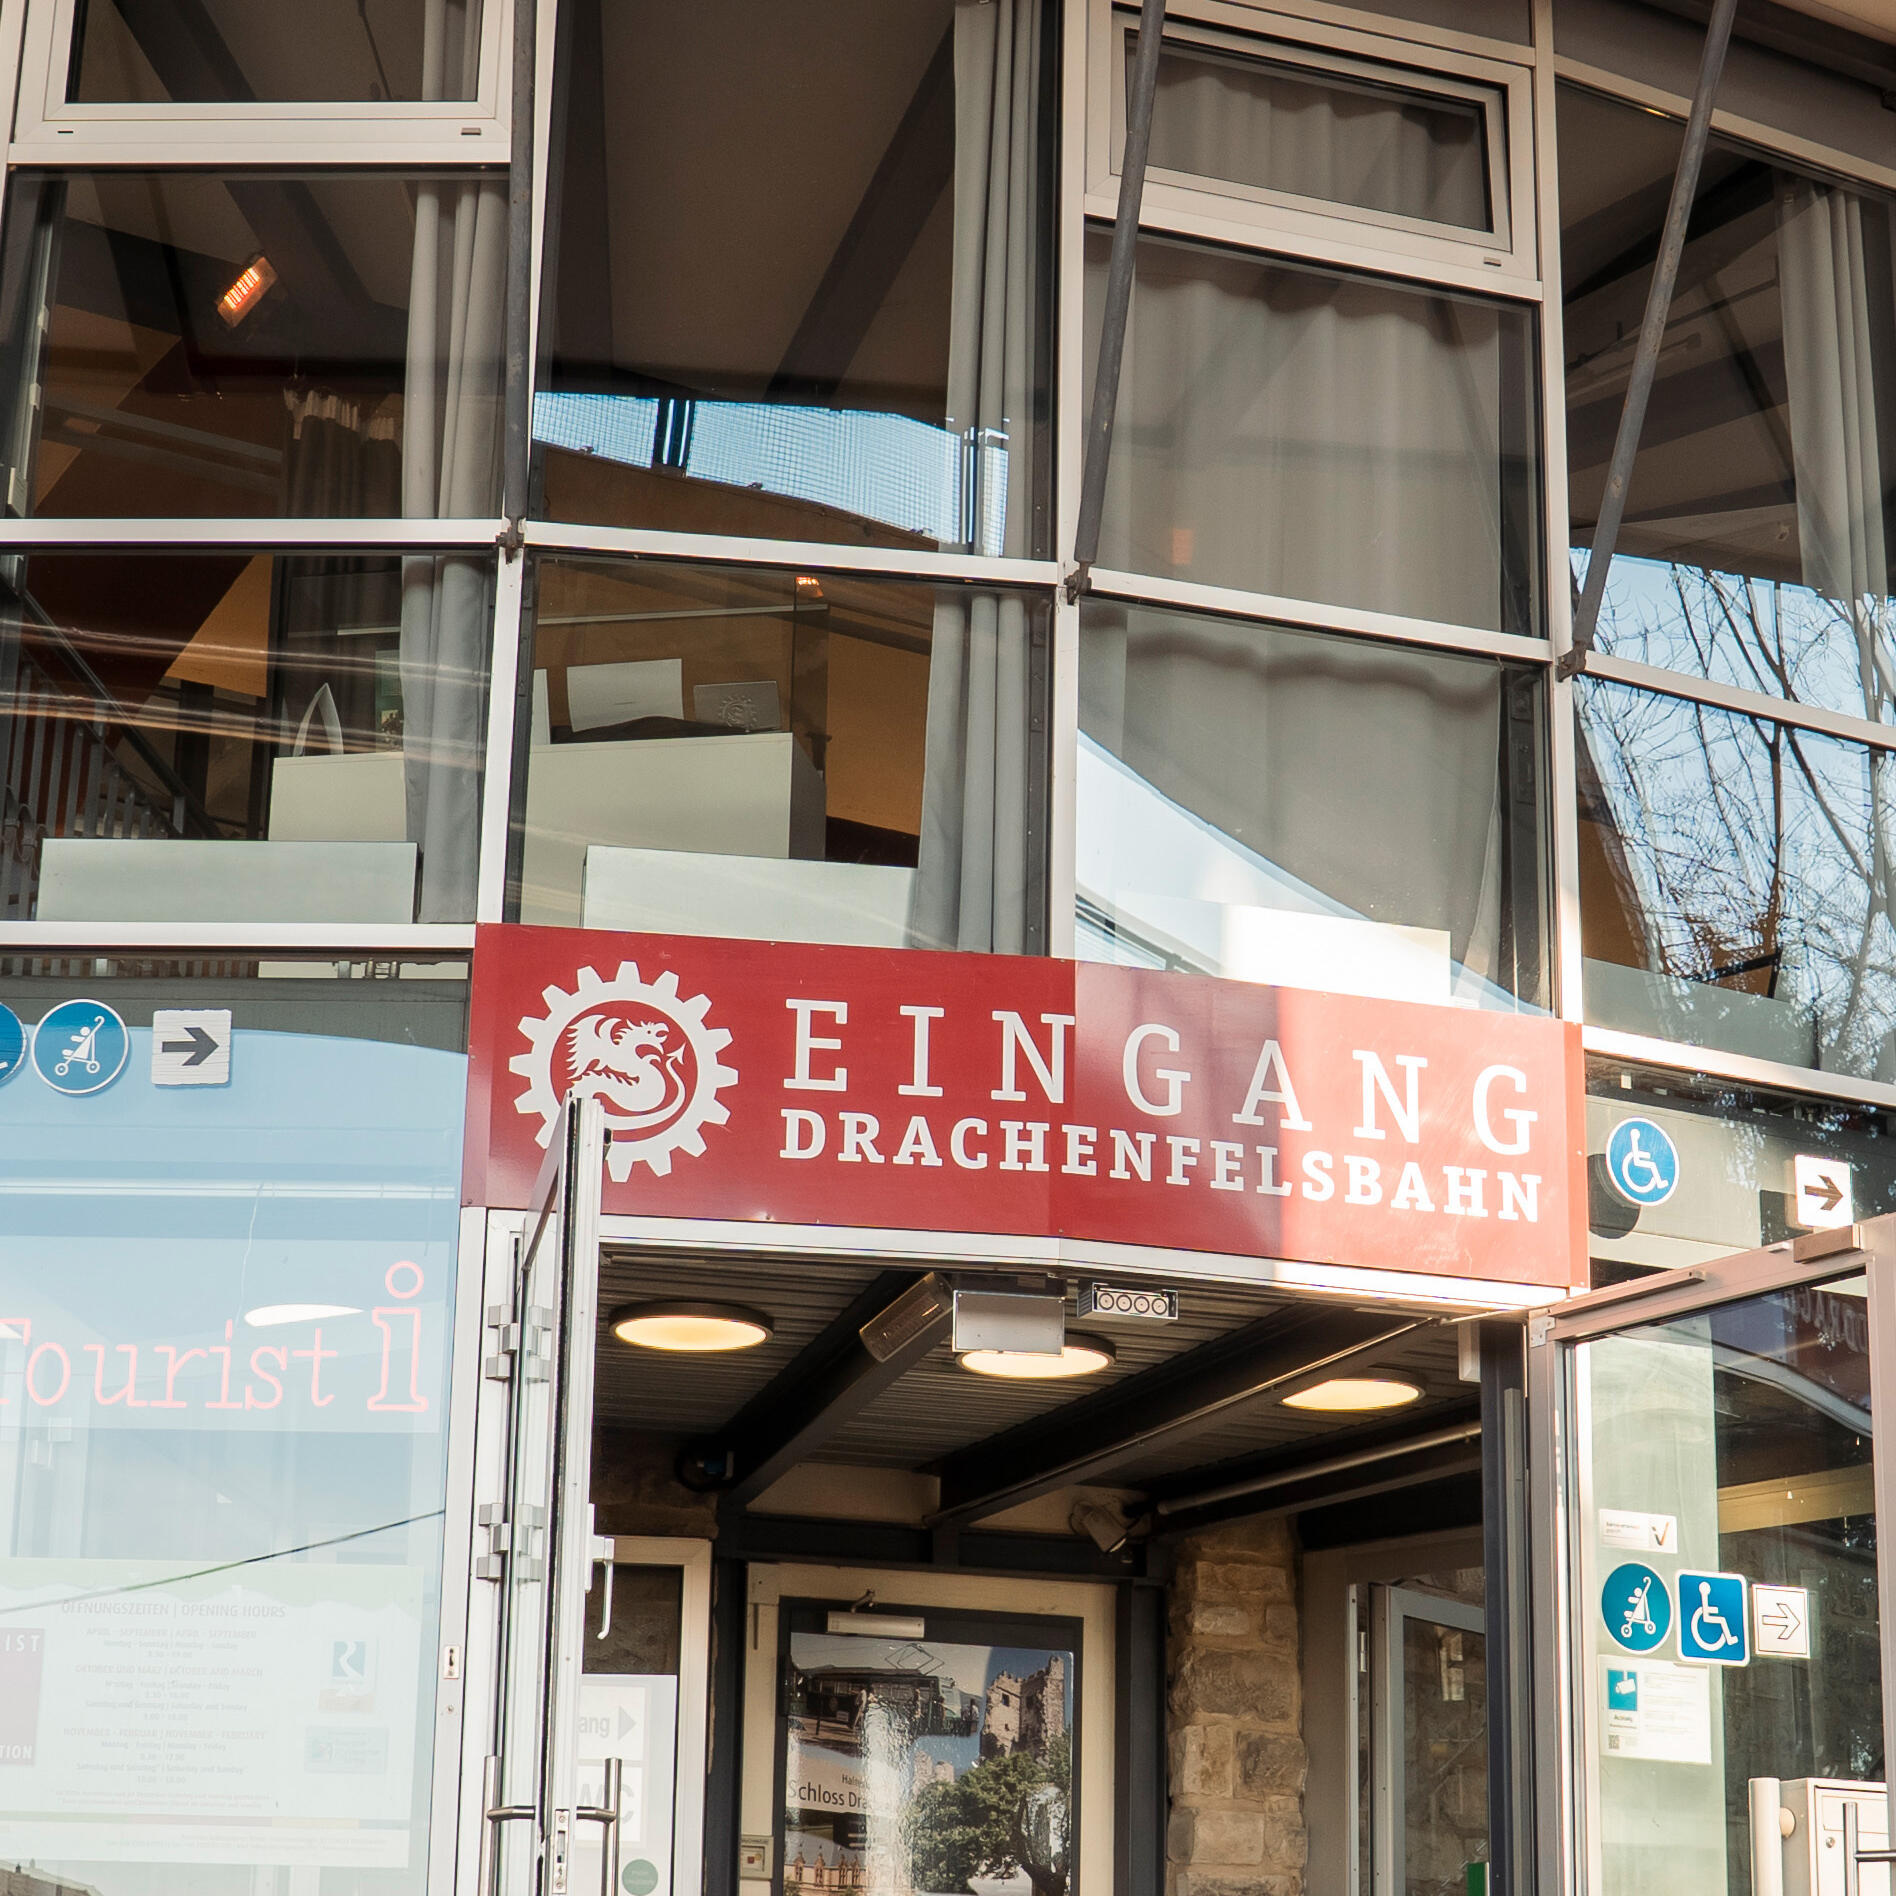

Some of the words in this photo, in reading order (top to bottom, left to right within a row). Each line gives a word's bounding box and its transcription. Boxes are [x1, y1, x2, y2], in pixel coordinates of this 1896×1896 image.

[784, 997, 1540, 1156] EINGANG
[780, 1109, 1542, 1224] DRACHENFELSBAHN
[181, 1603, 239, 1617] OPENING
[242, 1604, 286, 1618] HOURS
[788, 1779, 845, 1806] Schloss
